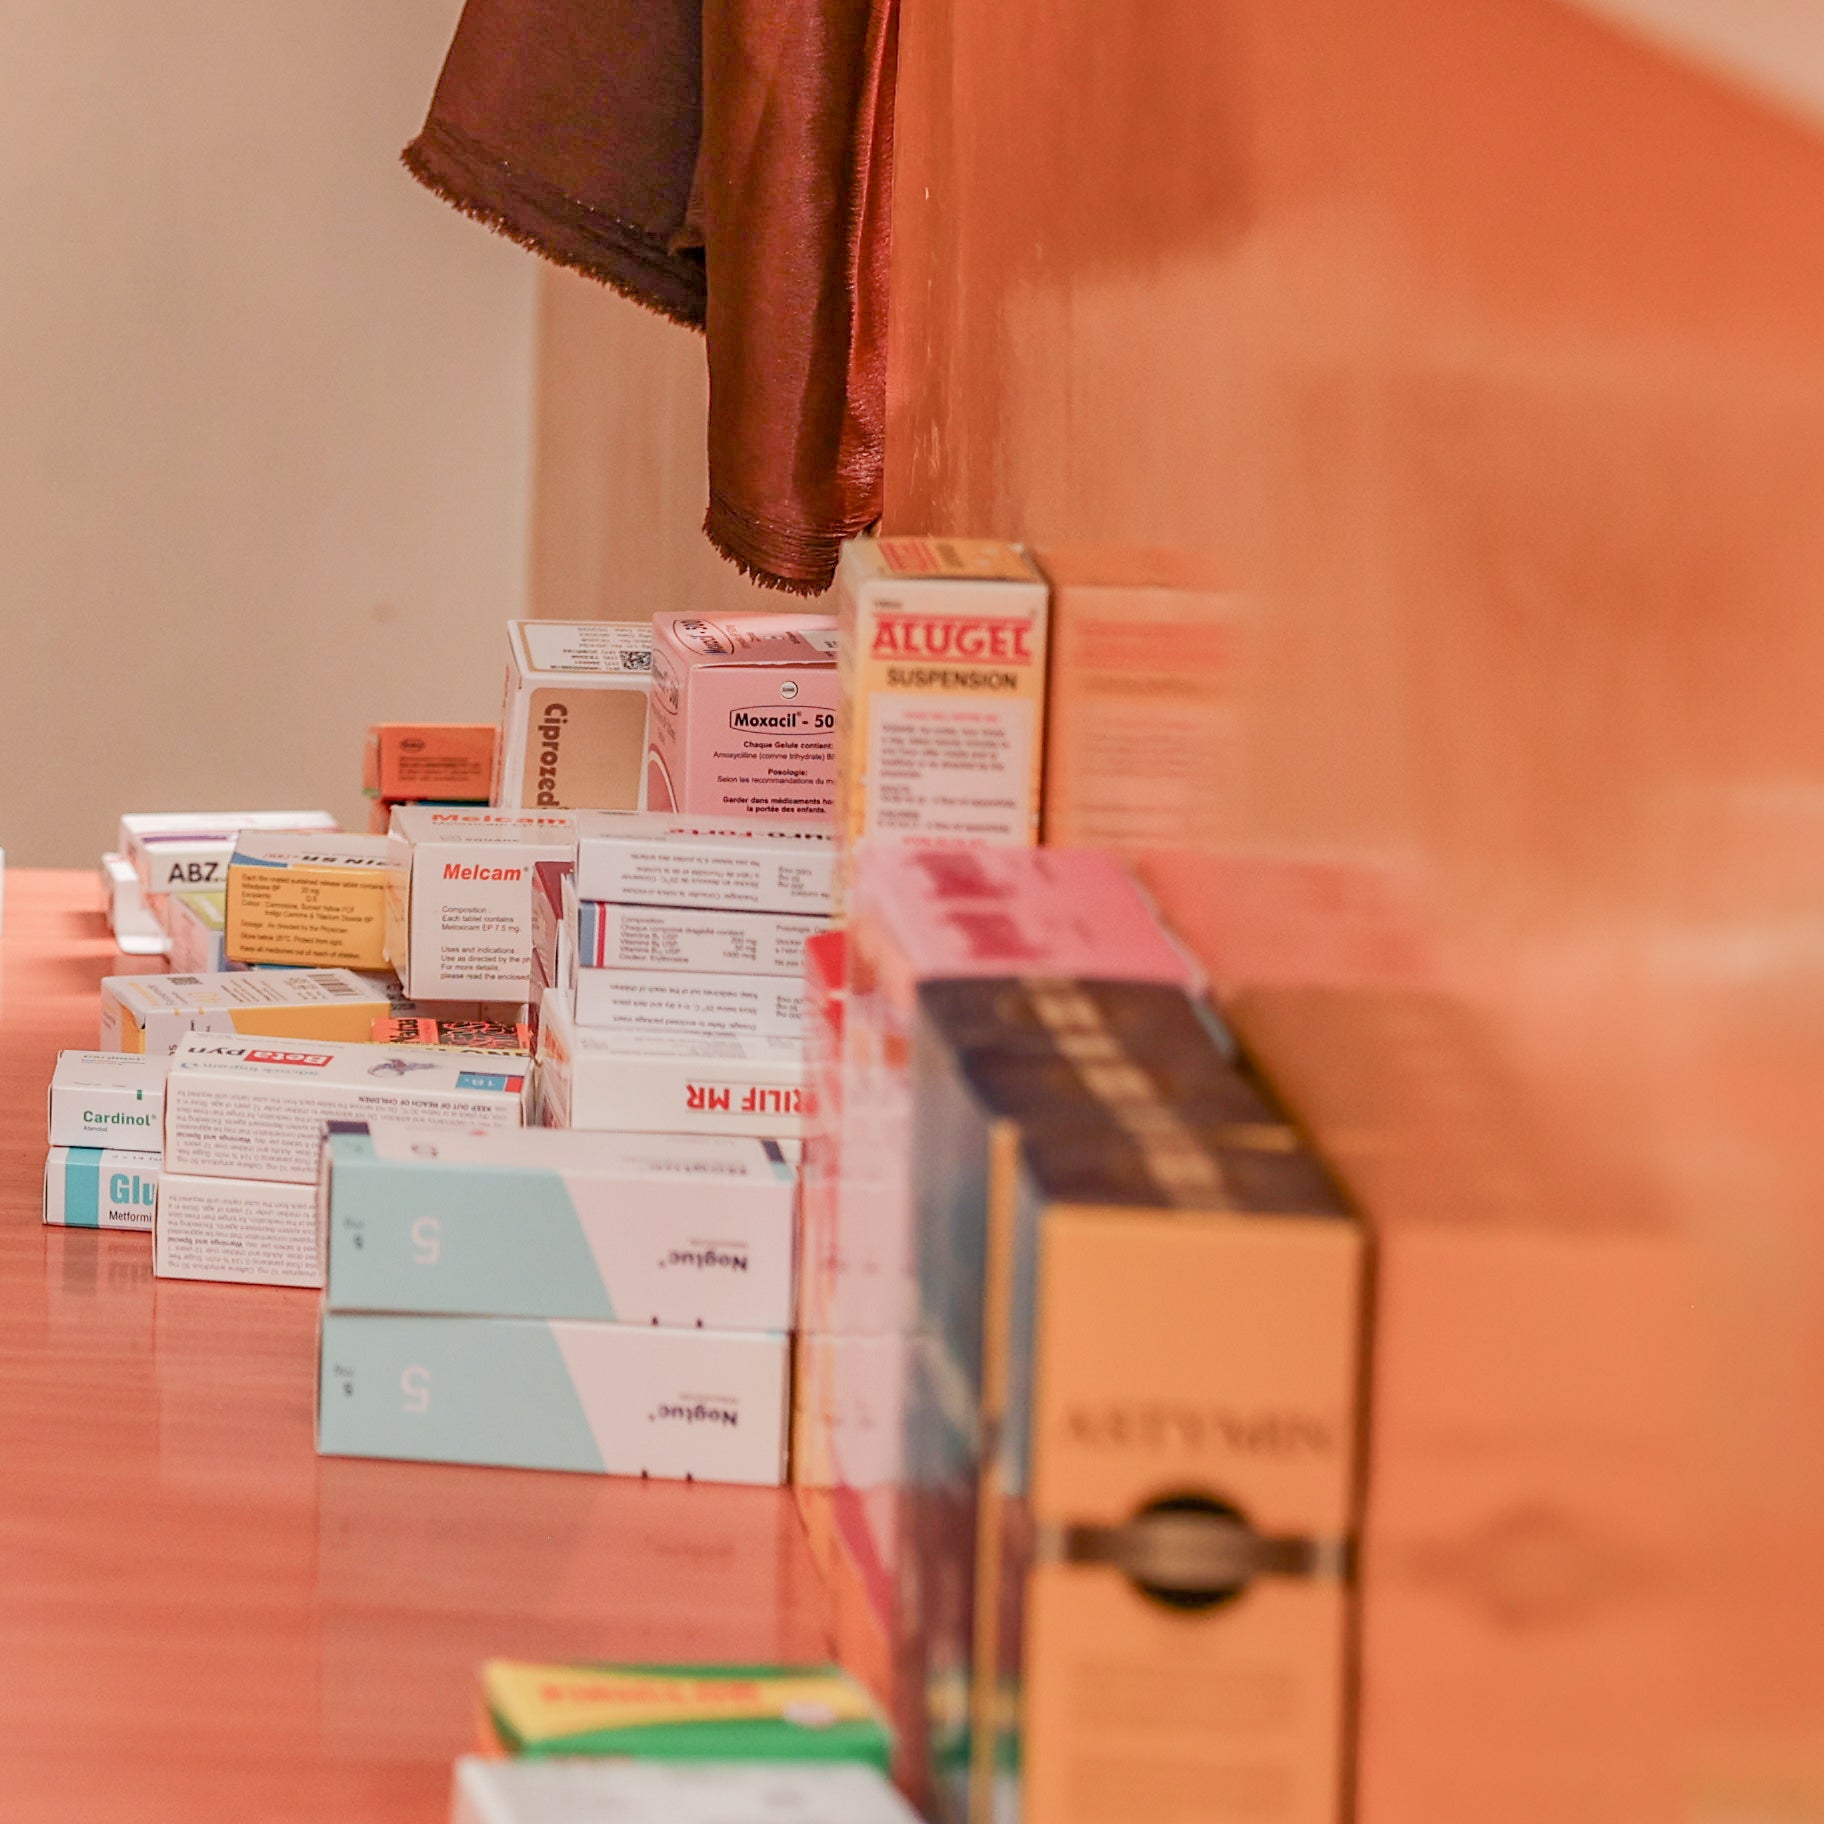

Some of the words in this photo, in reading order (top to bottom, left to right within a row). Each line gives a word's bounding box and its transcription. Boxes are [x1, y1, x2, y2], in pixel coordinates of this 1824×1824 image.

[871, 617, 1034, 659] ALUGEL
[887, 667, 1018, 692] SUSPENSION
[734, 712, 797, 728] Moxacil
[537, 702, 569, 808] Ciprozed
[443, 863, 522, 881] Melcam
[686, 1083, 730, 1112] MR
[83, 1109, 151, 1127] Cardinol
[109, 1172, 156, 1207] Glu
[109, 1209, 152, 1223] Metformi
[668, 1250, 749, 1272] Nogluc
[657, 1403, 739, 1427] Nogluc
